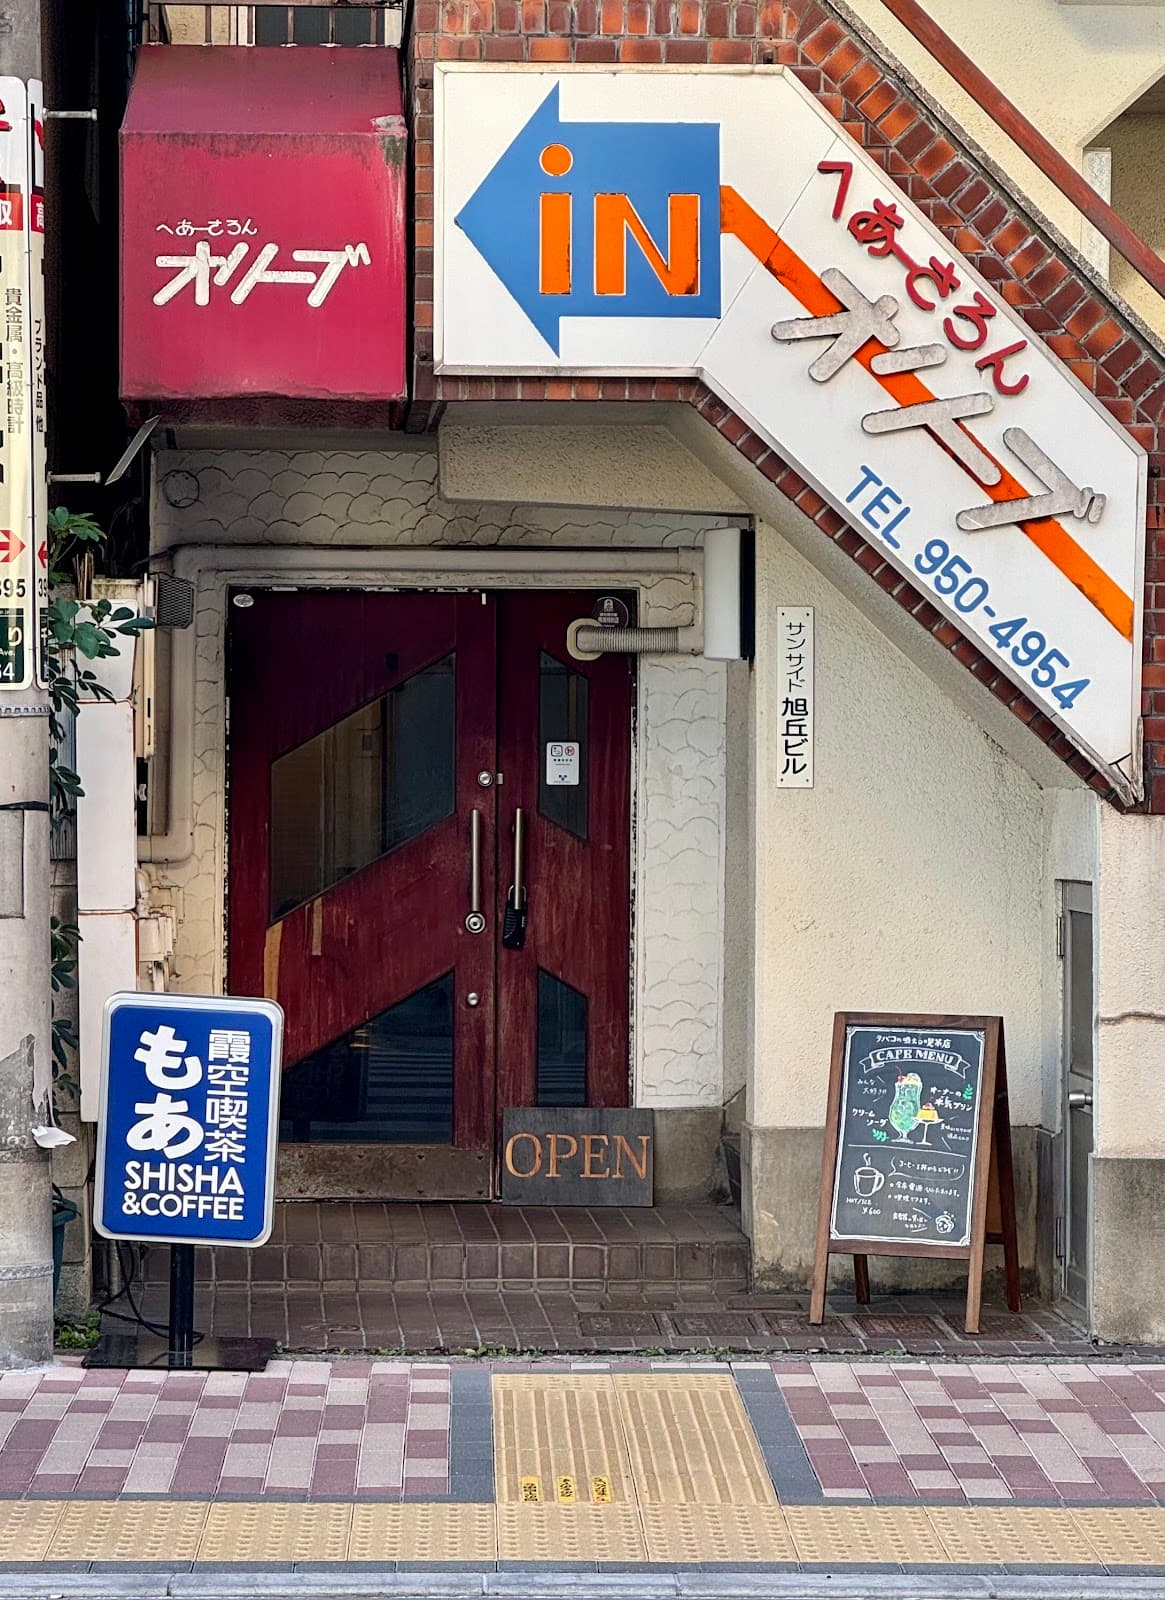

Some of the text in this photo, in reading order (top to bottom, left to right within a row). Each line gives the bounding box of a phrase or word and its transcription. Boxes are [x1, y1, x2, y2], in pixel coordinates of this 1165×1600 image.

[156, 219, 258, 236] へあーさろん
[0, 578, 26, 598] 95
[846, 465, 1090, 709] TEL 950-4954
[781, 697, 809, 776] 旭丘ビル
[876, 1049, 954, 1064] CAFE MENU
[126, 1025, 205, 1159] もあ
[203, 1029, 251, 1164] 霞空喫茶
[852, 1108, 876, 1117] クリーム
[505, 1132, 651, 1180] OPEN
[124, 1160, 245, 1196] SHISHA
[121, 1191, 245, 1221] &COFFEE
